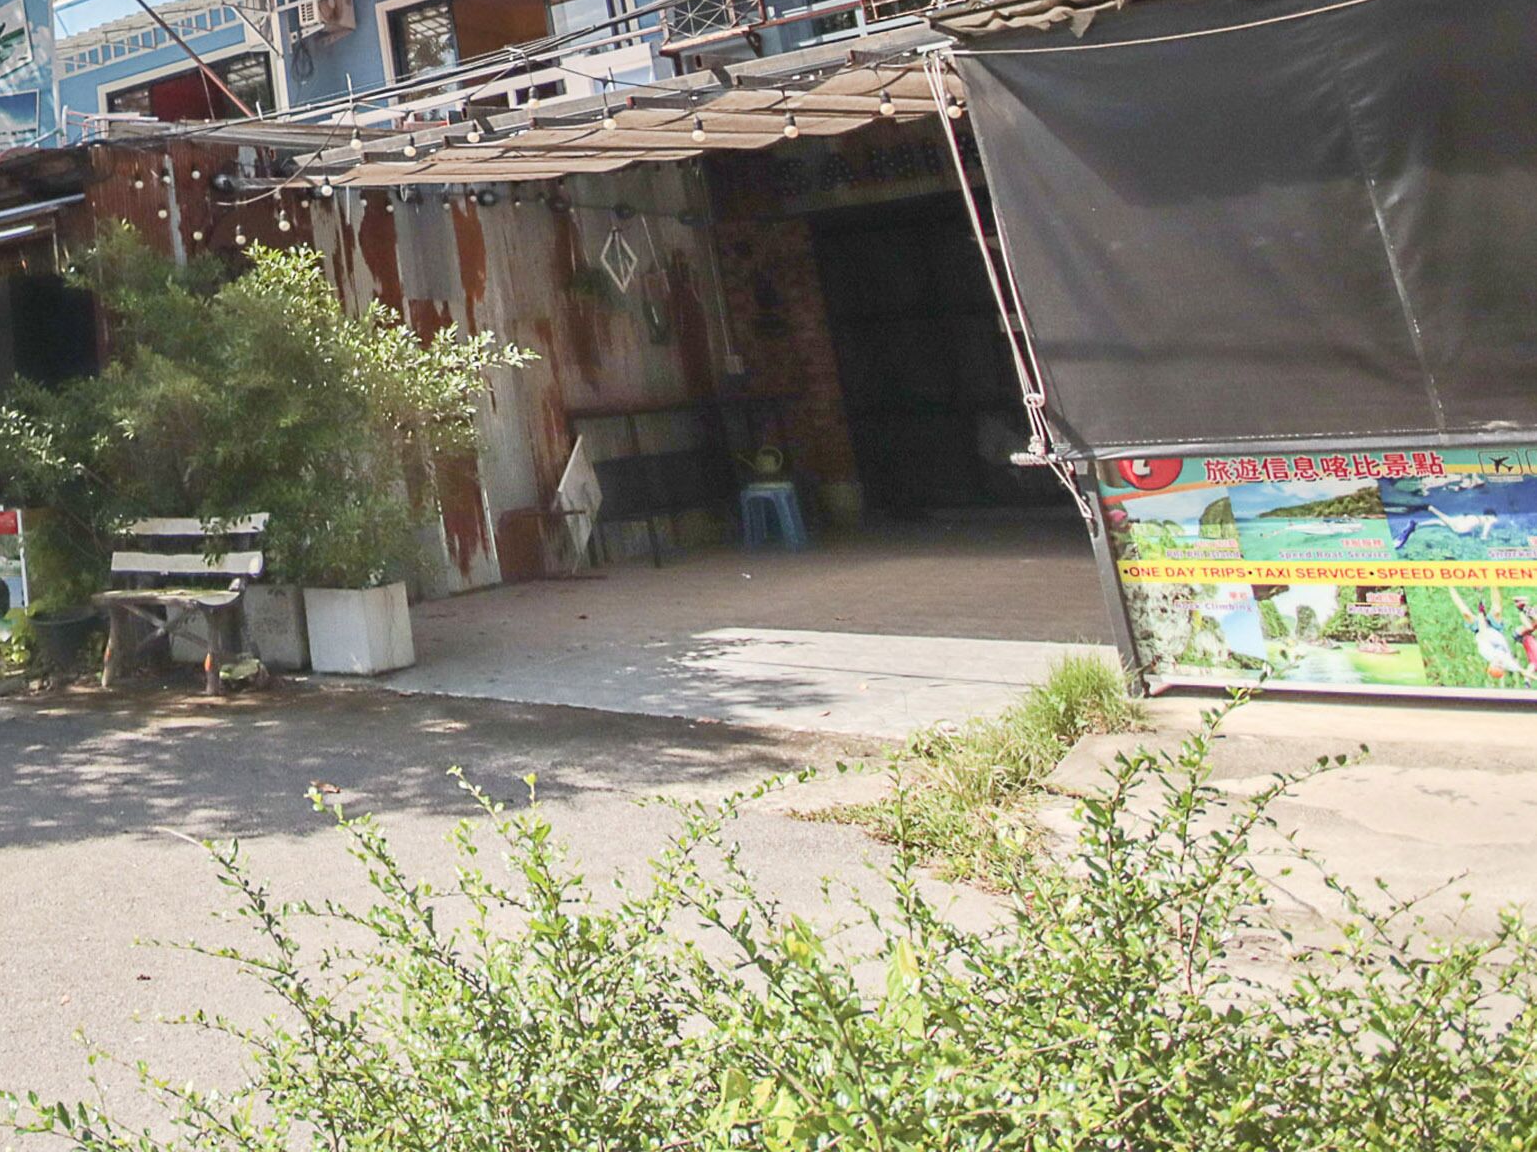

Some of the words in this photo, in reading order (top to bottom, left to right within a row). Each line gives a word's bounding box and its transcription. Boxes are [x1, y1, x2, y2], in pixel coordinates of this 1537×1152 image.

[1204, 450, 1445, 484] 旅遊信息喀比景點
[1130, 566, 1160, 578] ONE
[1165, 566, 1196, 578] DAY
[1203, 567, 1246, 579] TRIPS
[1256, 567, 1291, 579] TAXI
[1296, 567, 1366, 580] SERVICE
[1377, 567, 1435, 580] SPEED
[1440, 567, 1489, 580] BOAT
